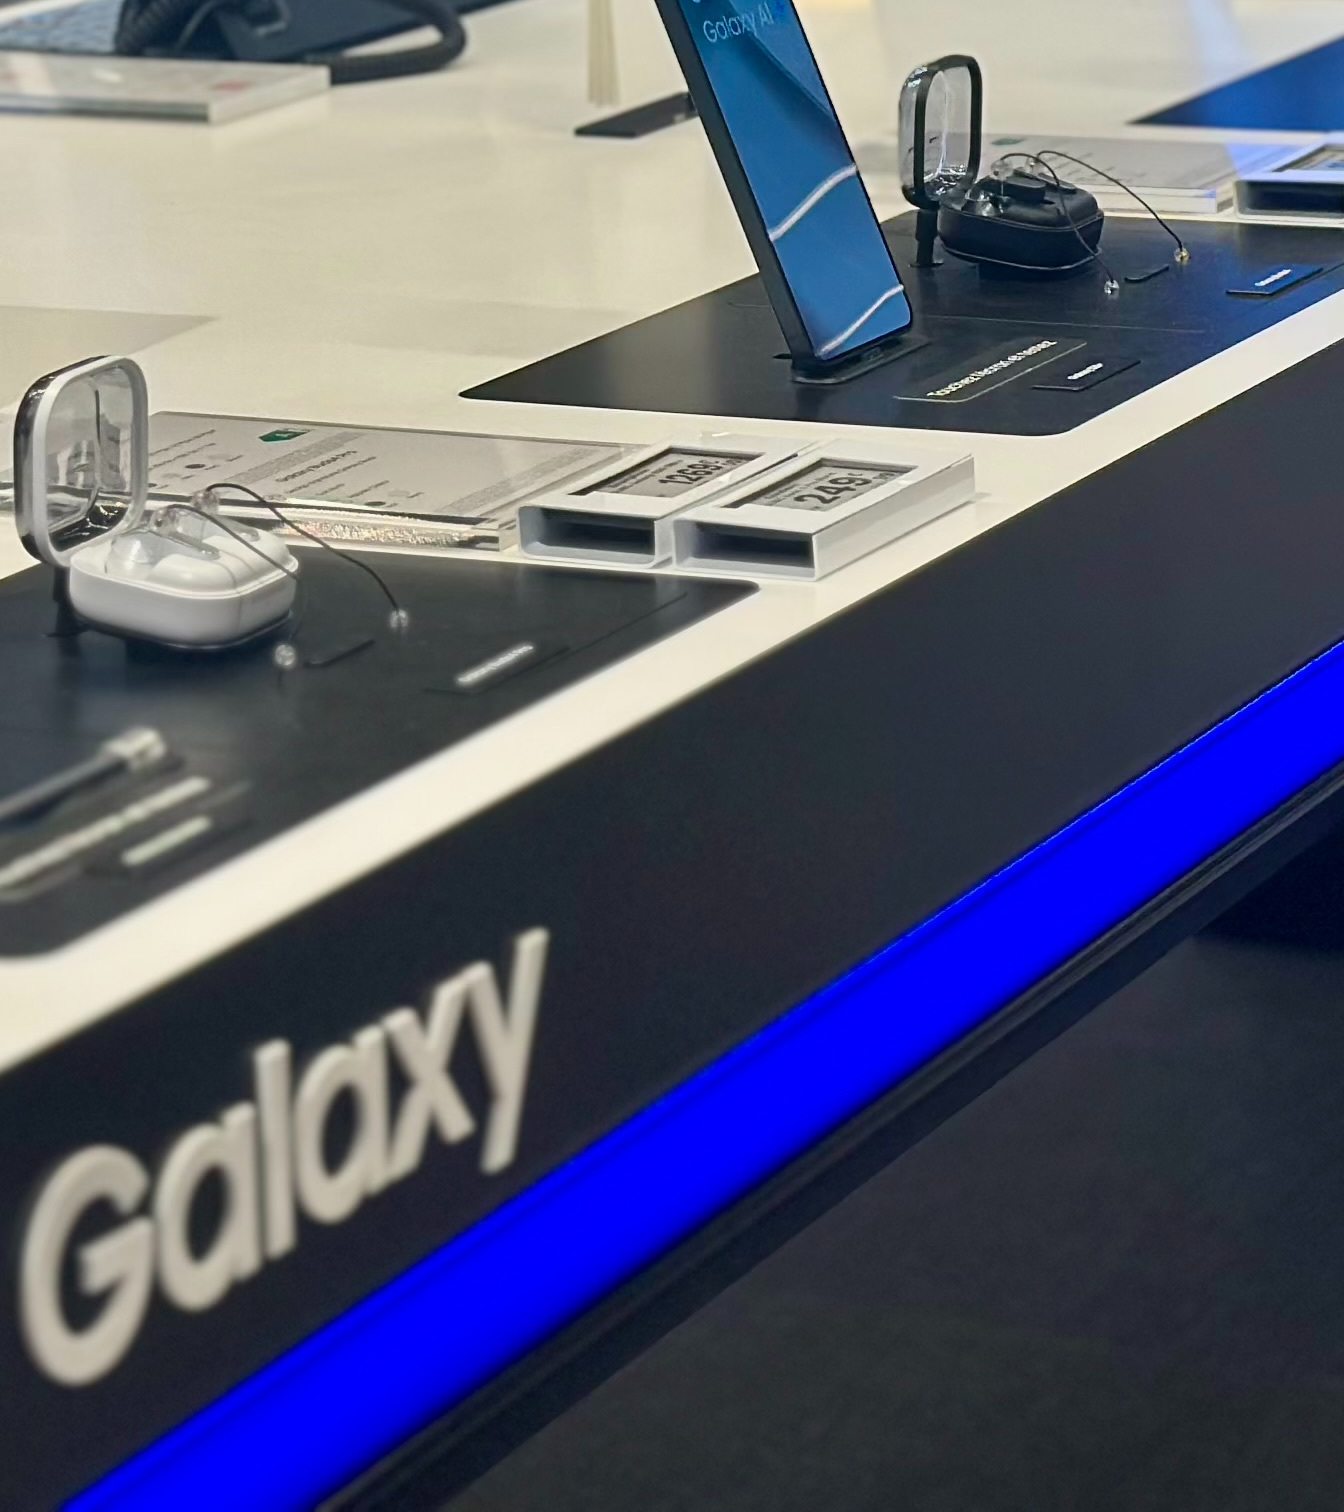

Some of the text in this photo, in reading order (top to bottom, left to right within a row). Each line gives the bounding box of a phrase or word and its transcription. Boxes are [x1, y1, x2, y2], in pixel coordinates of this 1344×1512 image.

[703, 2, 774, 43] Galaxy AI
[22, 927, 549, 1387] Galaxy
